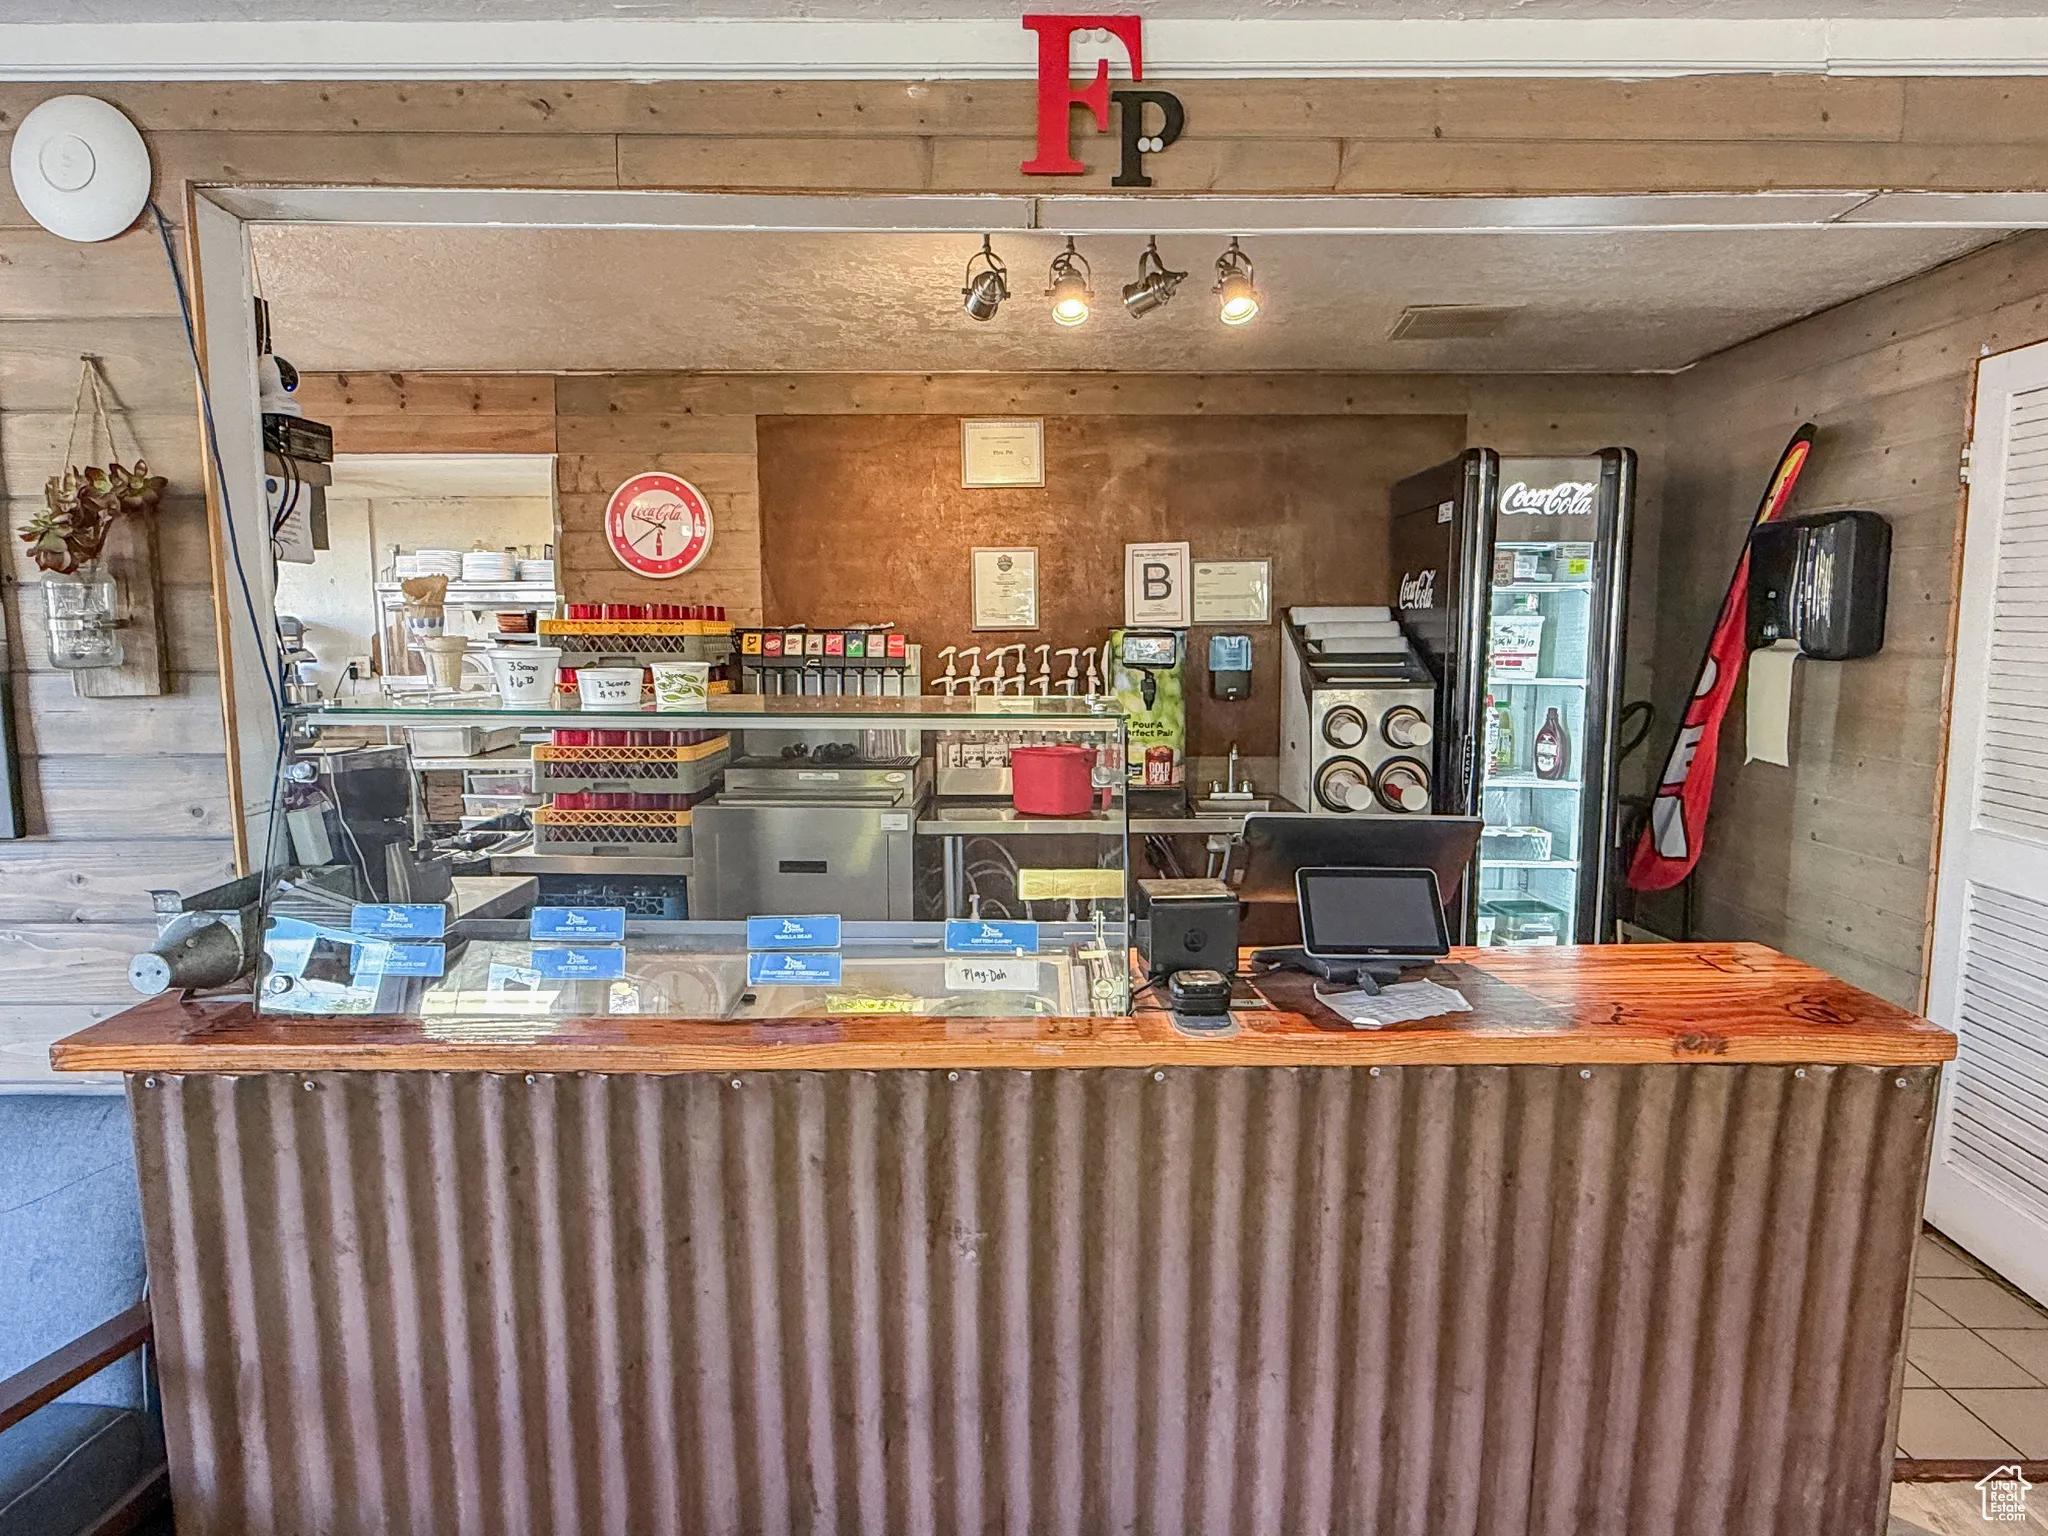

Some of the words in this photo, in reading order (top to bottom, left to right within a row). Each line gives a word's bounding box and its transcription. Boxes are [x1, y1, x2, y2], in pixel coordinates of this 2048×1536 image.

[1500, 482, 1598, 515] Coca-Cola
[1143, 563, 1172, 600] B
[508, 661, 516, 671] 3
[1133, 721, 1154, 729] Pour
[1149, 761, 1170, 773] GOLD
[1149, 773, 1170, 782] PEAK
[961, 967, 1007, 983] Play-Doh
